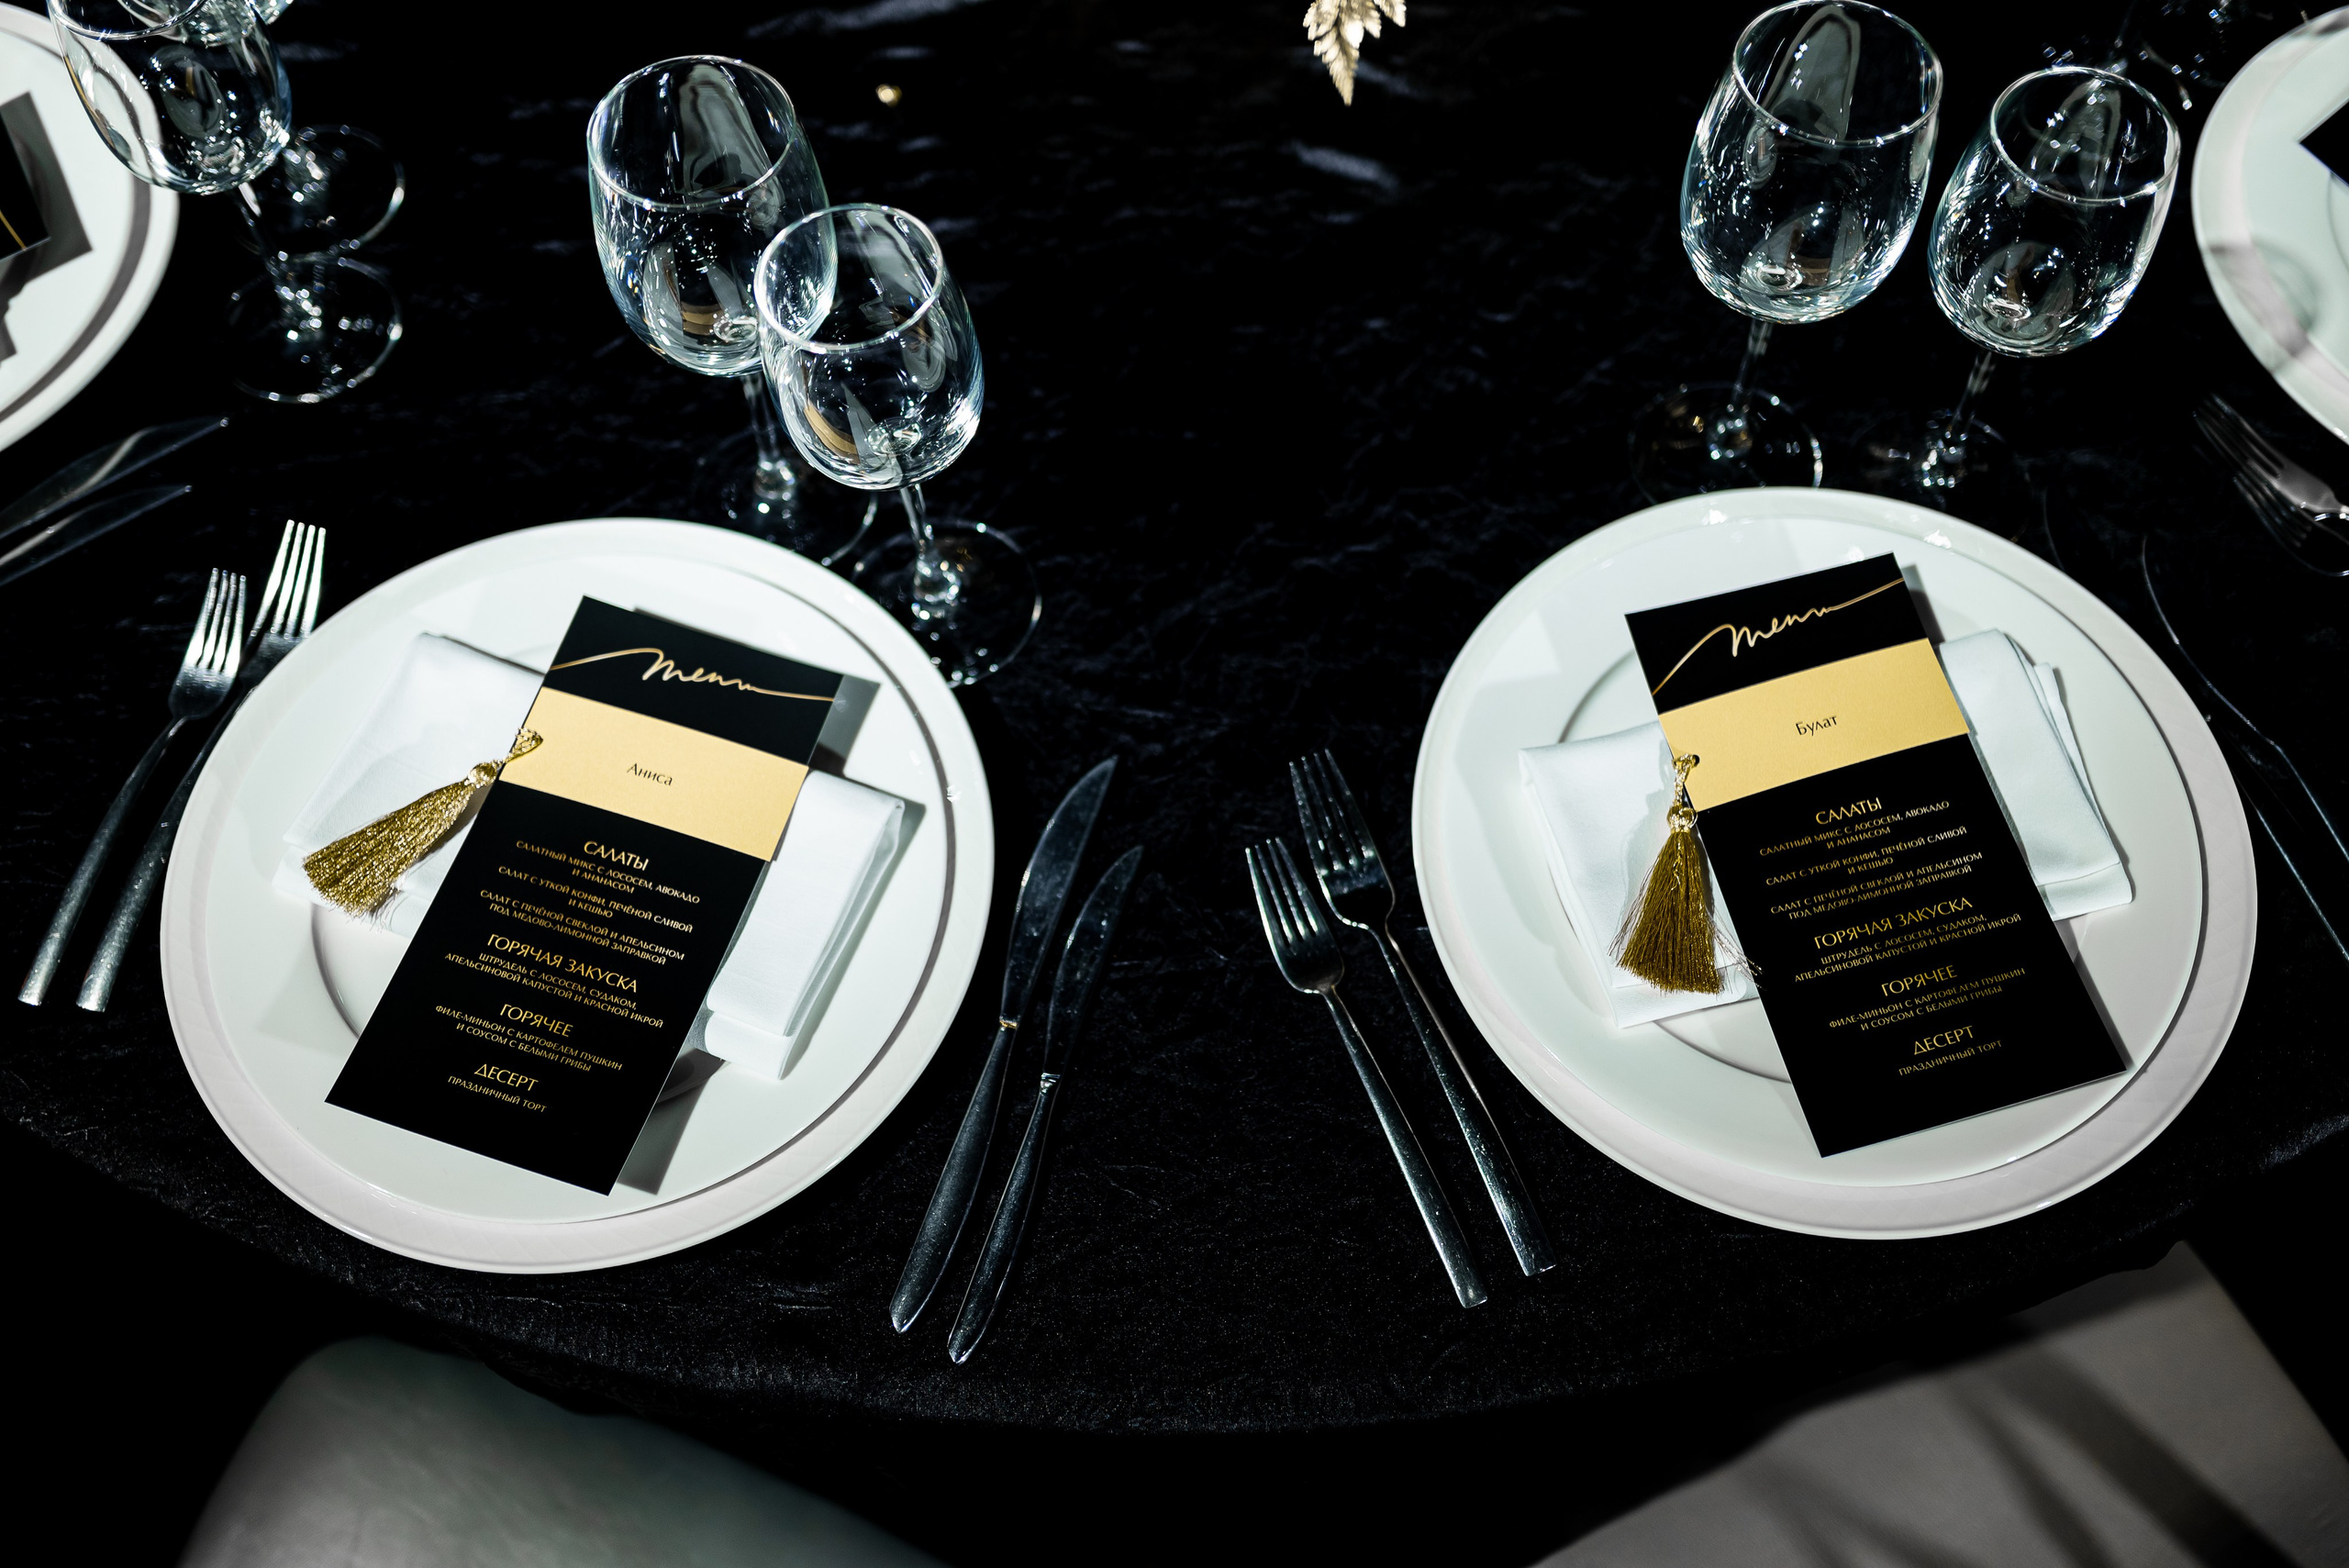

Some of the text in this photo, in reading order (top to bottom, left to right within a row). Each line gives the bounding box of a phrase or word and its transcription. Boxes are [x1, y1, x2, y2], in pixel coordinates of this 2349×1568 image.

[1795, 714, 1839, 738] Булат
[627, 762, 674, 787] Аниса
[1815, 796, 1883, 825] САЛАТЫ
[516, 840, 701, 905] САЛАТНЫЙ МИКС С ЛОСОСЕМ, АВОКАДО
[583, 840, 650, 872] САЛАТЫ
[498, 865, 694, 934] САЛАТ С УТКОЙ КОНФИ, ПЕЧЁНОЙ СЛИВОЙ
[572, 868, 635, 895] И АНАНАСОМ
[480, 889, 685, 961] САЛАТ С ПЕЧЁНОЙ СВЕКЛОЙ И АПЕЛЬСИНОМ
[568, 897, 614, 918] И КЕШЬЮ
[1813, 896, 1974, 950] ГОРЯЧАЯ ЗАКУСКА
[489, 902, 667, 966] ПОД МЕДОВО-ЛИМОННОЙ ЗАПРАВКОЙ
[478, 952, 637, 1011] ШТРУДЕЛЬ С ЛОСОСЕМ, СУДАКОМ,
[486, 933, 637, 994] ГОРЯЧАЯ ЗАКУСКА
[1881, 964, 1958, 997] ГОРЯЧЕЕ
[444, 952, 664, 1029] АПЕЛЬСИНОВОЙ КАПУСТОЙ И КРАСНОЙ ИКРОЙ
[435, 1005, 623, 1071] ФИЛЕ-МИНЬОН С КАРТОФЕЛЕМ ПУШКИН
[499, 1003, 573, 1038] ГОРЯЧЕЕ
[455, 1022, 592, 1072] И СОУСОМ С БЕЛЫМИ ГРИБЫ
[1913, 1025, 1974, 1056] ДЕСЕРТ
[447, 1075, 548, 1113] ПРАЗДНИЧНЫЙ ТОРТ
[473, 1063, 540, 1092] ДЕСЕРТ
